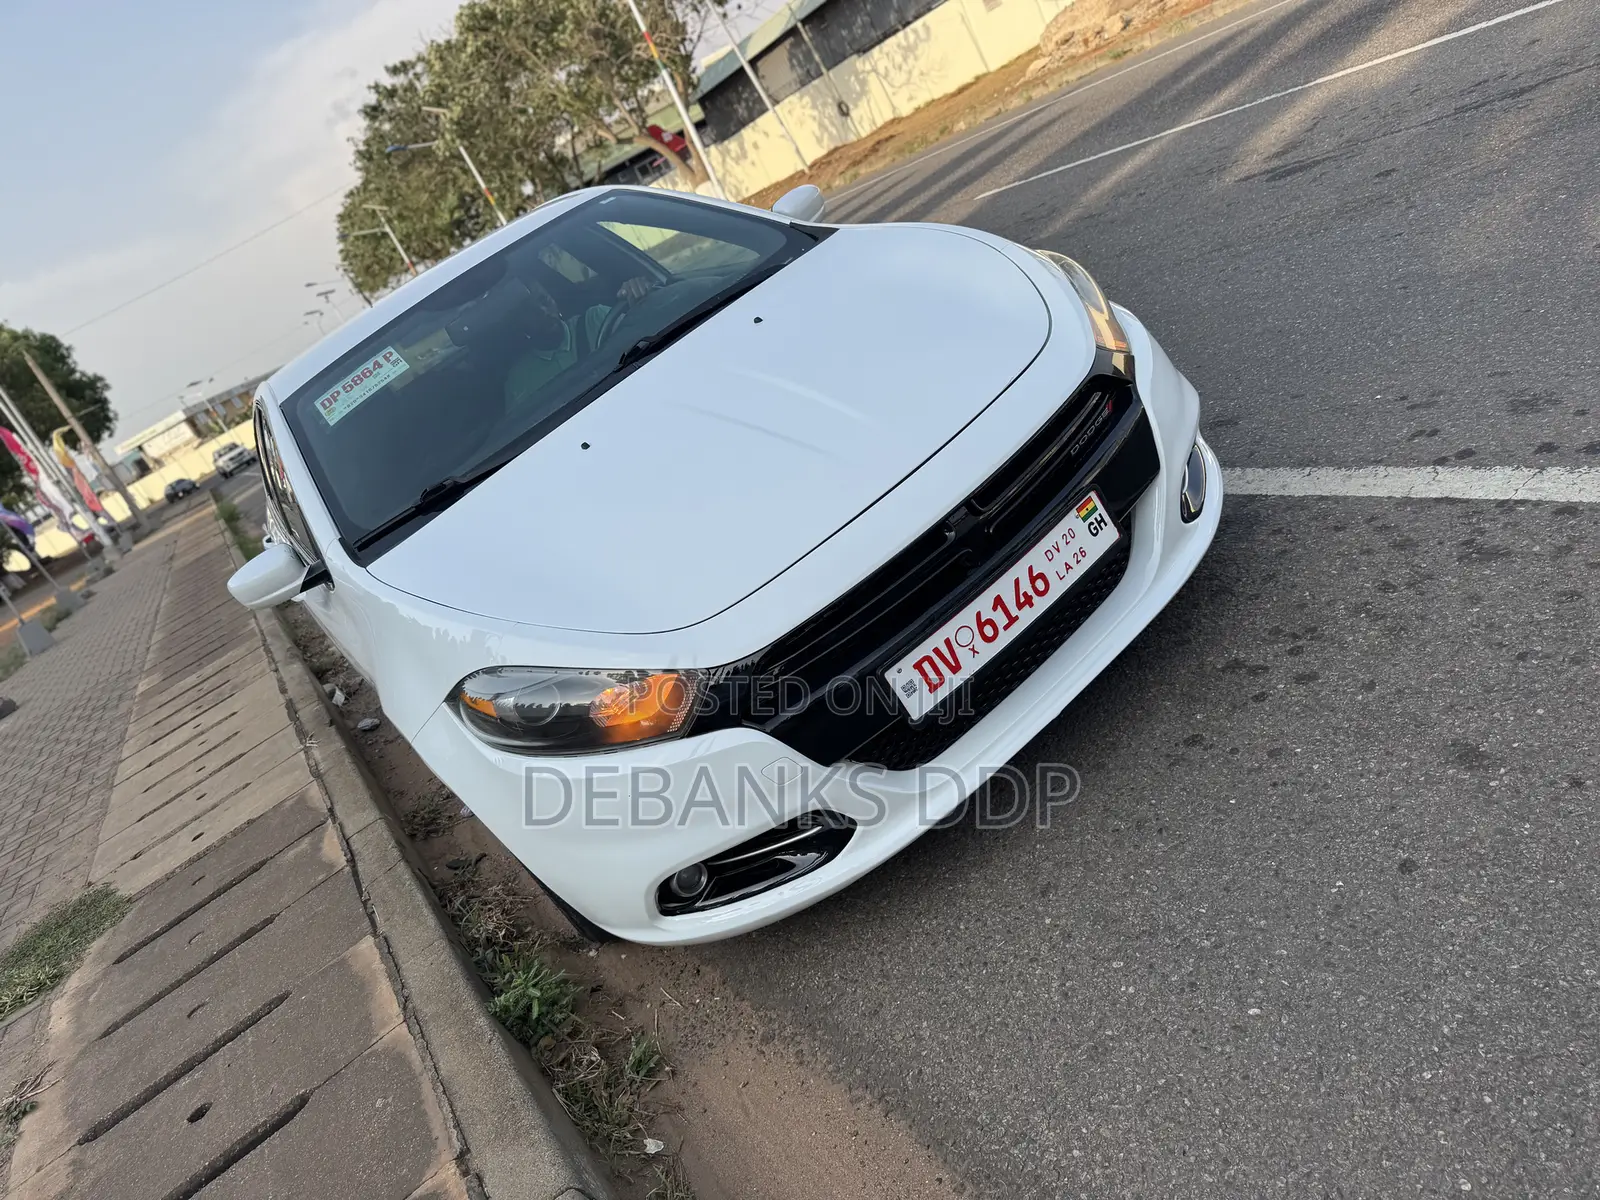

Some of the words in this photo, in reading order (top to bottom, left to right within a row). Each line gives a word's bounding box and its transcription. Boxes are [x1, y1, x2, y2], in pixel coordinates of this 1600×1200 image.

[320, 390, 341, 410] DP
[342, 360, 383, 393] 5864
[382, 351, 393, 363] P
[1071, 407, 1109, 455] DODGE
[1044, 541, 1060, 562] DV
[1062, 528, 1075, 545] 20
[1087, 513, 1107, 537] GH
[1056, 562, 1073, 580] LA
[1073, 547, 1086, 564] 26
[912, 637, 962, 694] DV
[976, 565, 1050, 643] 6146
